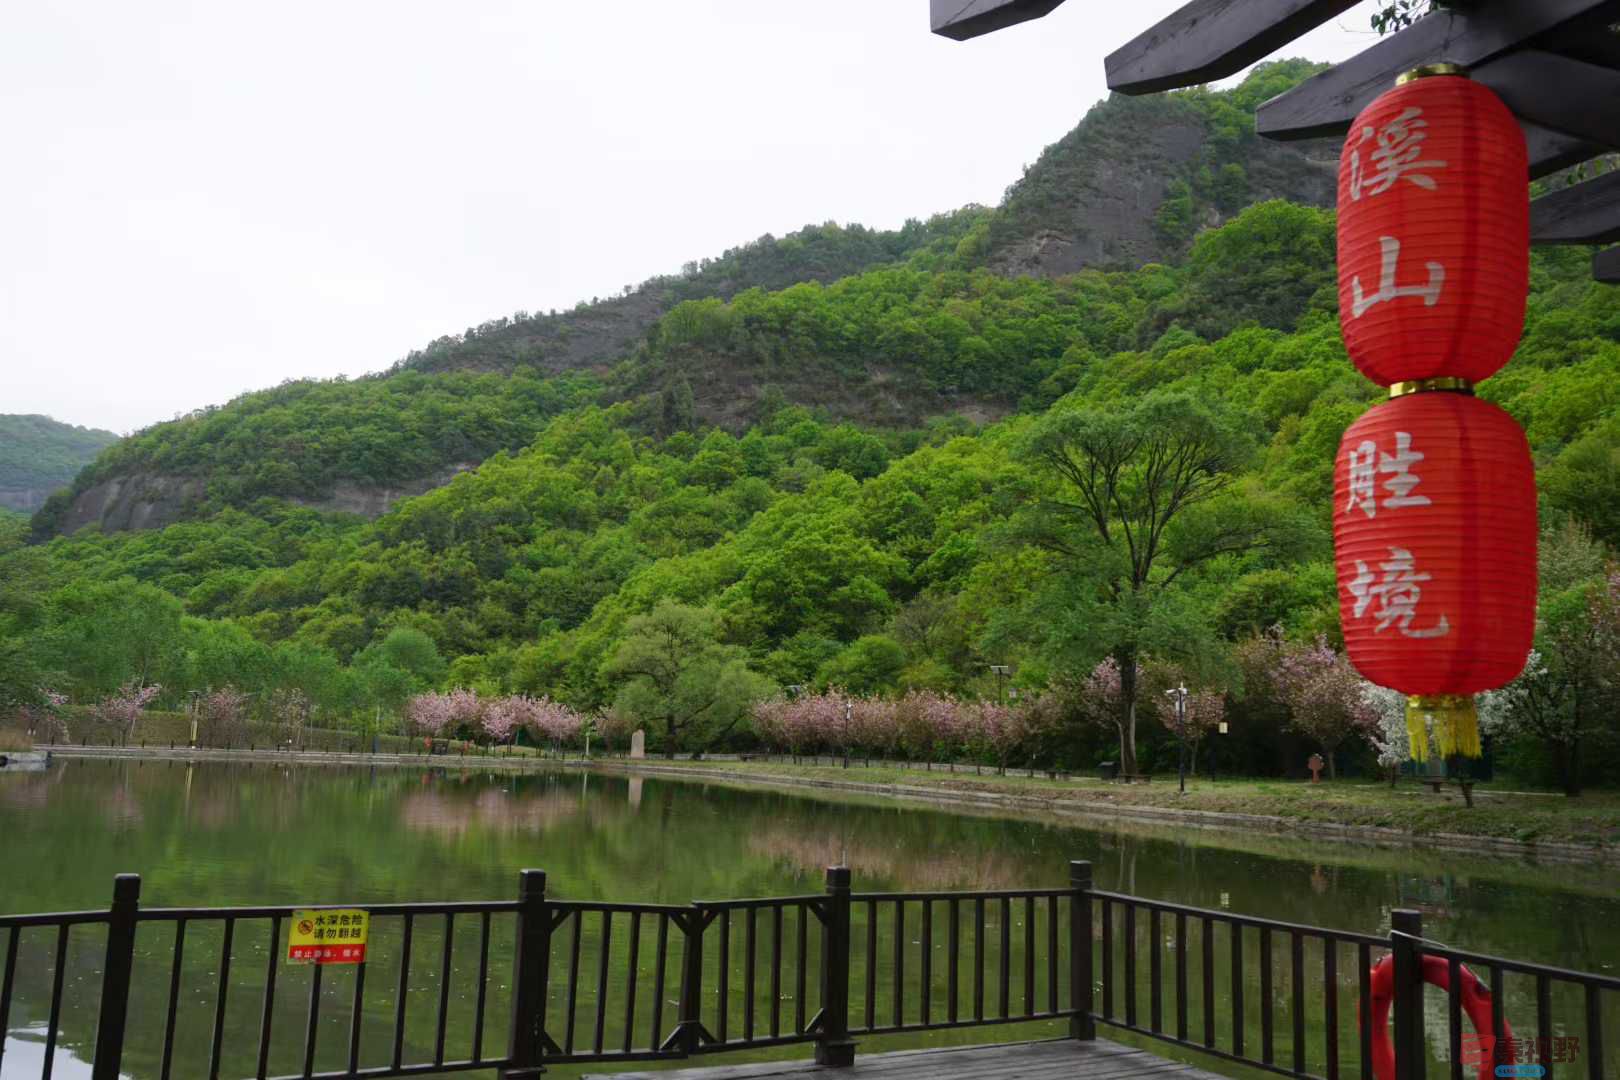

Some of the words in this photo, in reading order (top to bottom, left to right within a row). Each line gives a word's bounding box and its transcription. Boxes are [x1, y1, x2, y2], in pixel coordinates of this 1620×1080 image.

[1350, 106, 1448, 319] 溪山
[314, 914, 363, 926] 水深危险
[314, 928, 362, 939] 请勿翻越
